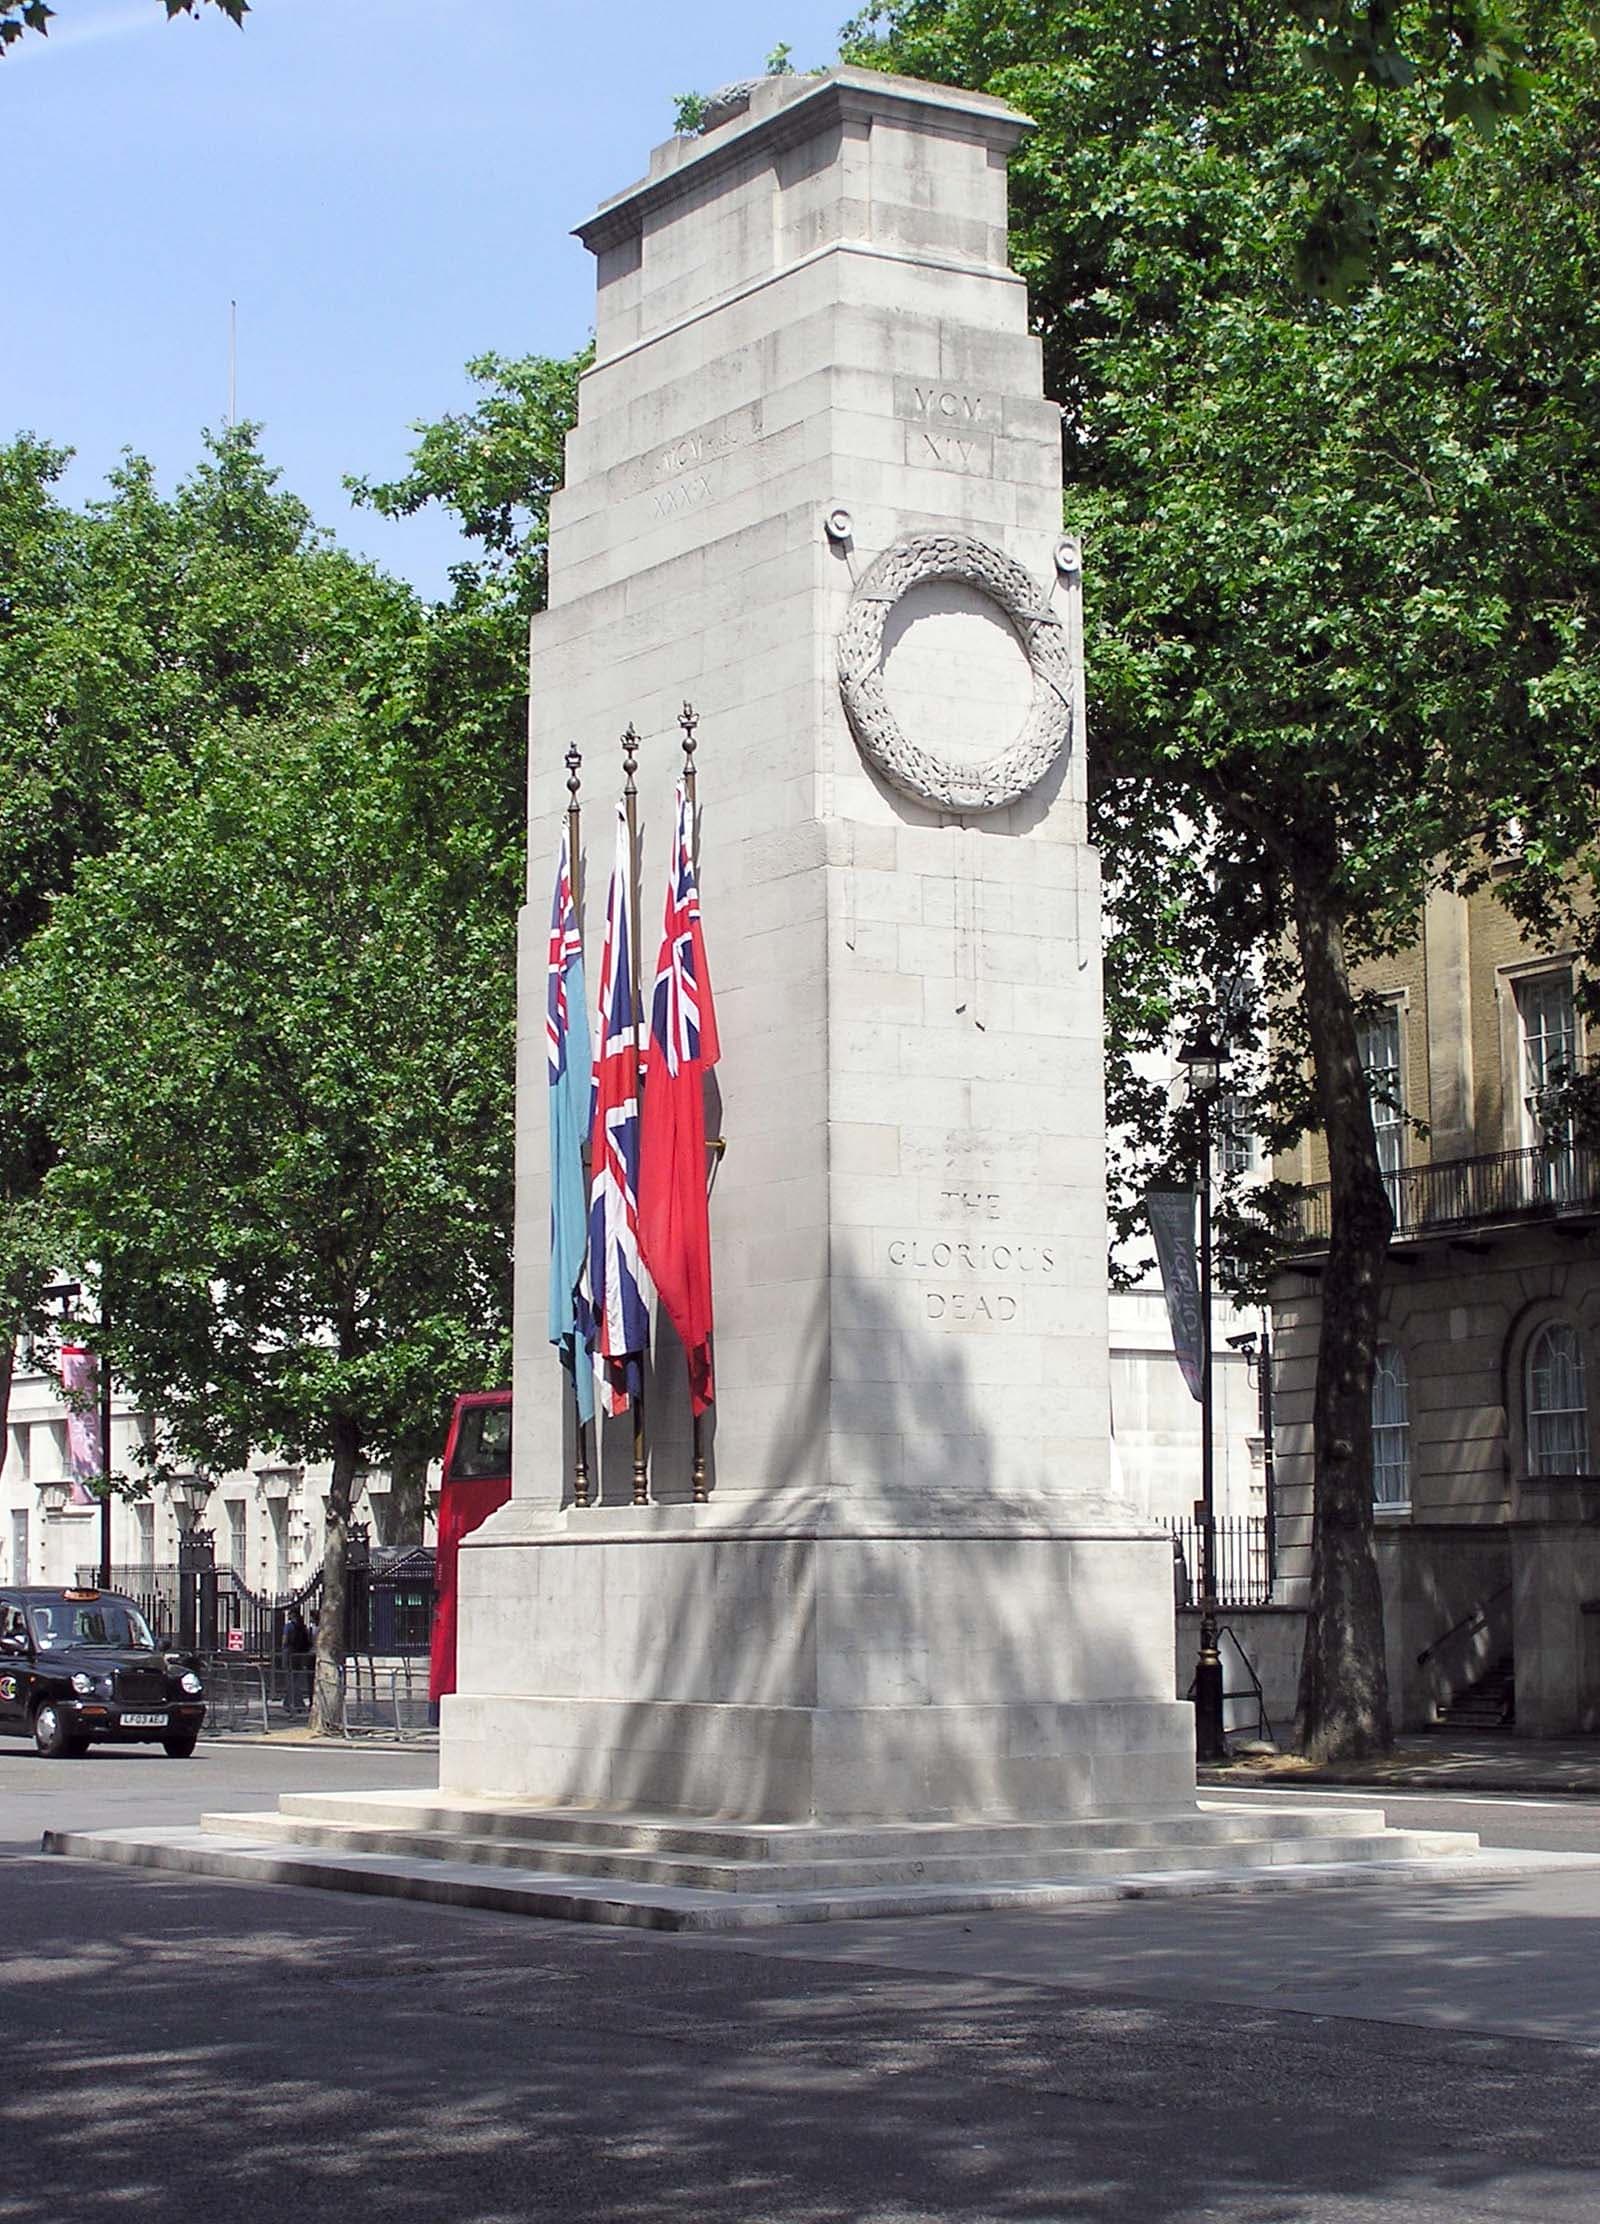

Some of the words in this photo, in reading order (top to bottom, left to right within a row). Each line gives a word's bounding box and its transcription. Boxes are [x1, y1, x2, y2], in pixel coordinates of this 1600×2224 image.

[940, 1191, 1000, 1220] THE
[888, 1240, 1054, 1272] GLORIOUS
[927, 1293, 1017, 1321] DEAD
